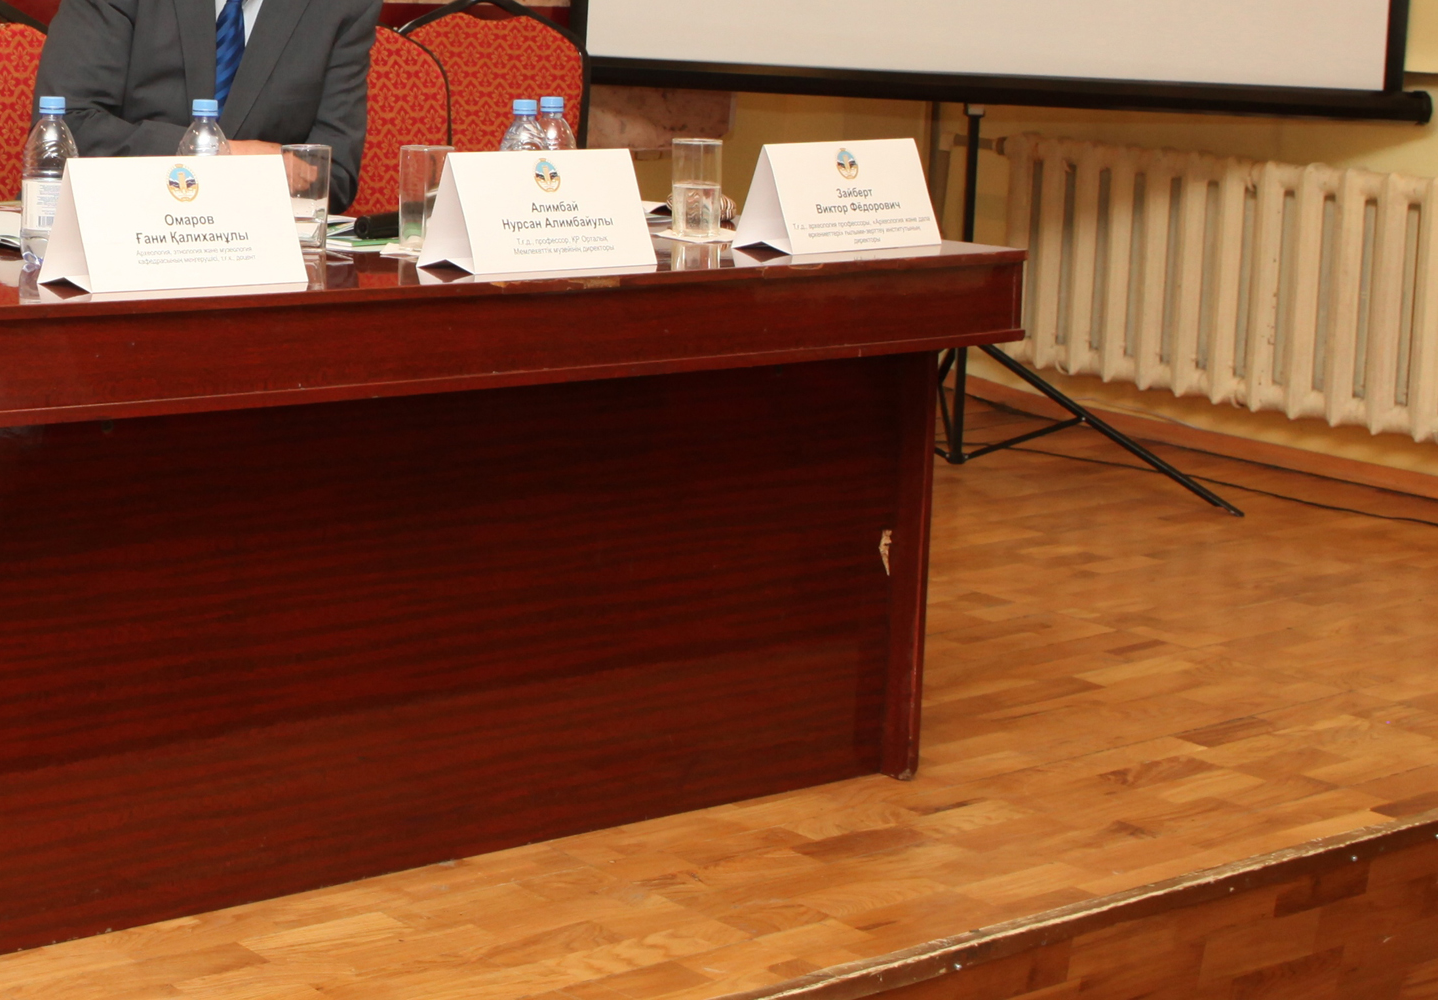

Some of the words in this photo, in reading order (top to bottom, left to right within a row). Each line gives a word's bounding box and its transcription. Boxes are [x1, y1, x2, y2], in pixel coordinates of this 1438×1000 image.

[835, 187, 873, 200] Зайберт
[530, 200, 579, 213] Алимбай
[815, 203, 849, 215] Виктор
[849, 200, 901, 213] Фёдорович
[164, 213, 215, 228] Омаров
[501, 218, 542, 232] Нурсан
[545, 215, 614, 229] Алимбайулы
[135, 232, 167, 244] Ғани
[169, 230, 250, 245] Қалиханұлы
